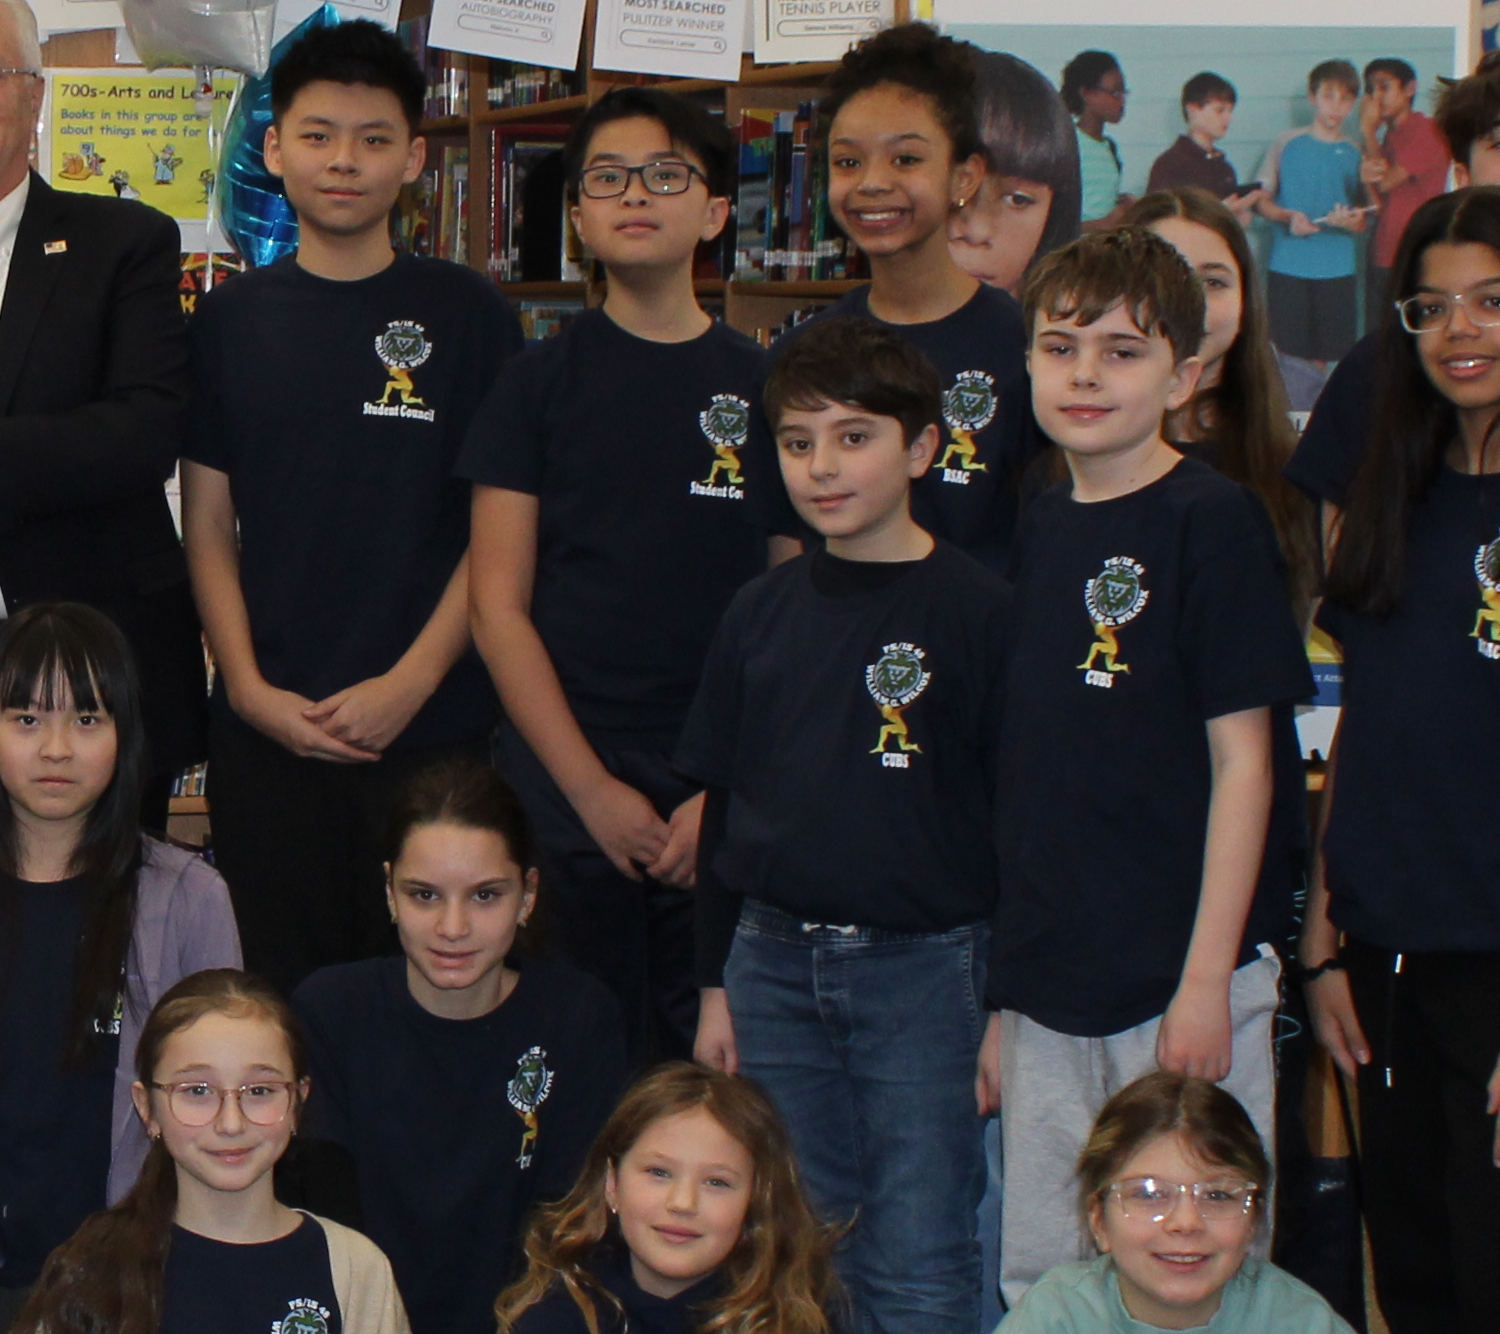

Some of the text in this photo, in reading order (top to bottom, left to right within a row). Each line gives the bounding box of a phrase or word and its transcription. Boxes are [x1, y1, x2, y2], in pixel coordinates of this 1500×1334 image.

[461, 2, 554, 24] AUTOBIOGRAPHY
[662, 0, 726, 15] SEARCHED
[779, 0, 881, 16] TENNIS PLAYER
[623, 12, 726, 32] PULITZER WINNER
[61, 83, 175, 99] 700s-Arts and
[61, 109, 95, 120] Books
[101, 109, 111, 120] in
[116, 109, 139, 120] this
[144, 112, 178, 124] group
[60, 124, 94, 135] about
[100, 125, 136, 139] things
[141, 127, 158, 136] we
[163, 125, 177, 137] do
[182, 125, 202, 137] for
[374, 335, 399, 367] WILLIAM
[362, 401, 435, 423] Student Council
[699, 410, 724, 444] WILLIAM
[689, 480, 727, 498] Student
[1115, 588, 1150, 625] WILCOX
[865, 664, 890, 705] WILLIAM
[899, 671, 932, 705] WILCOX
